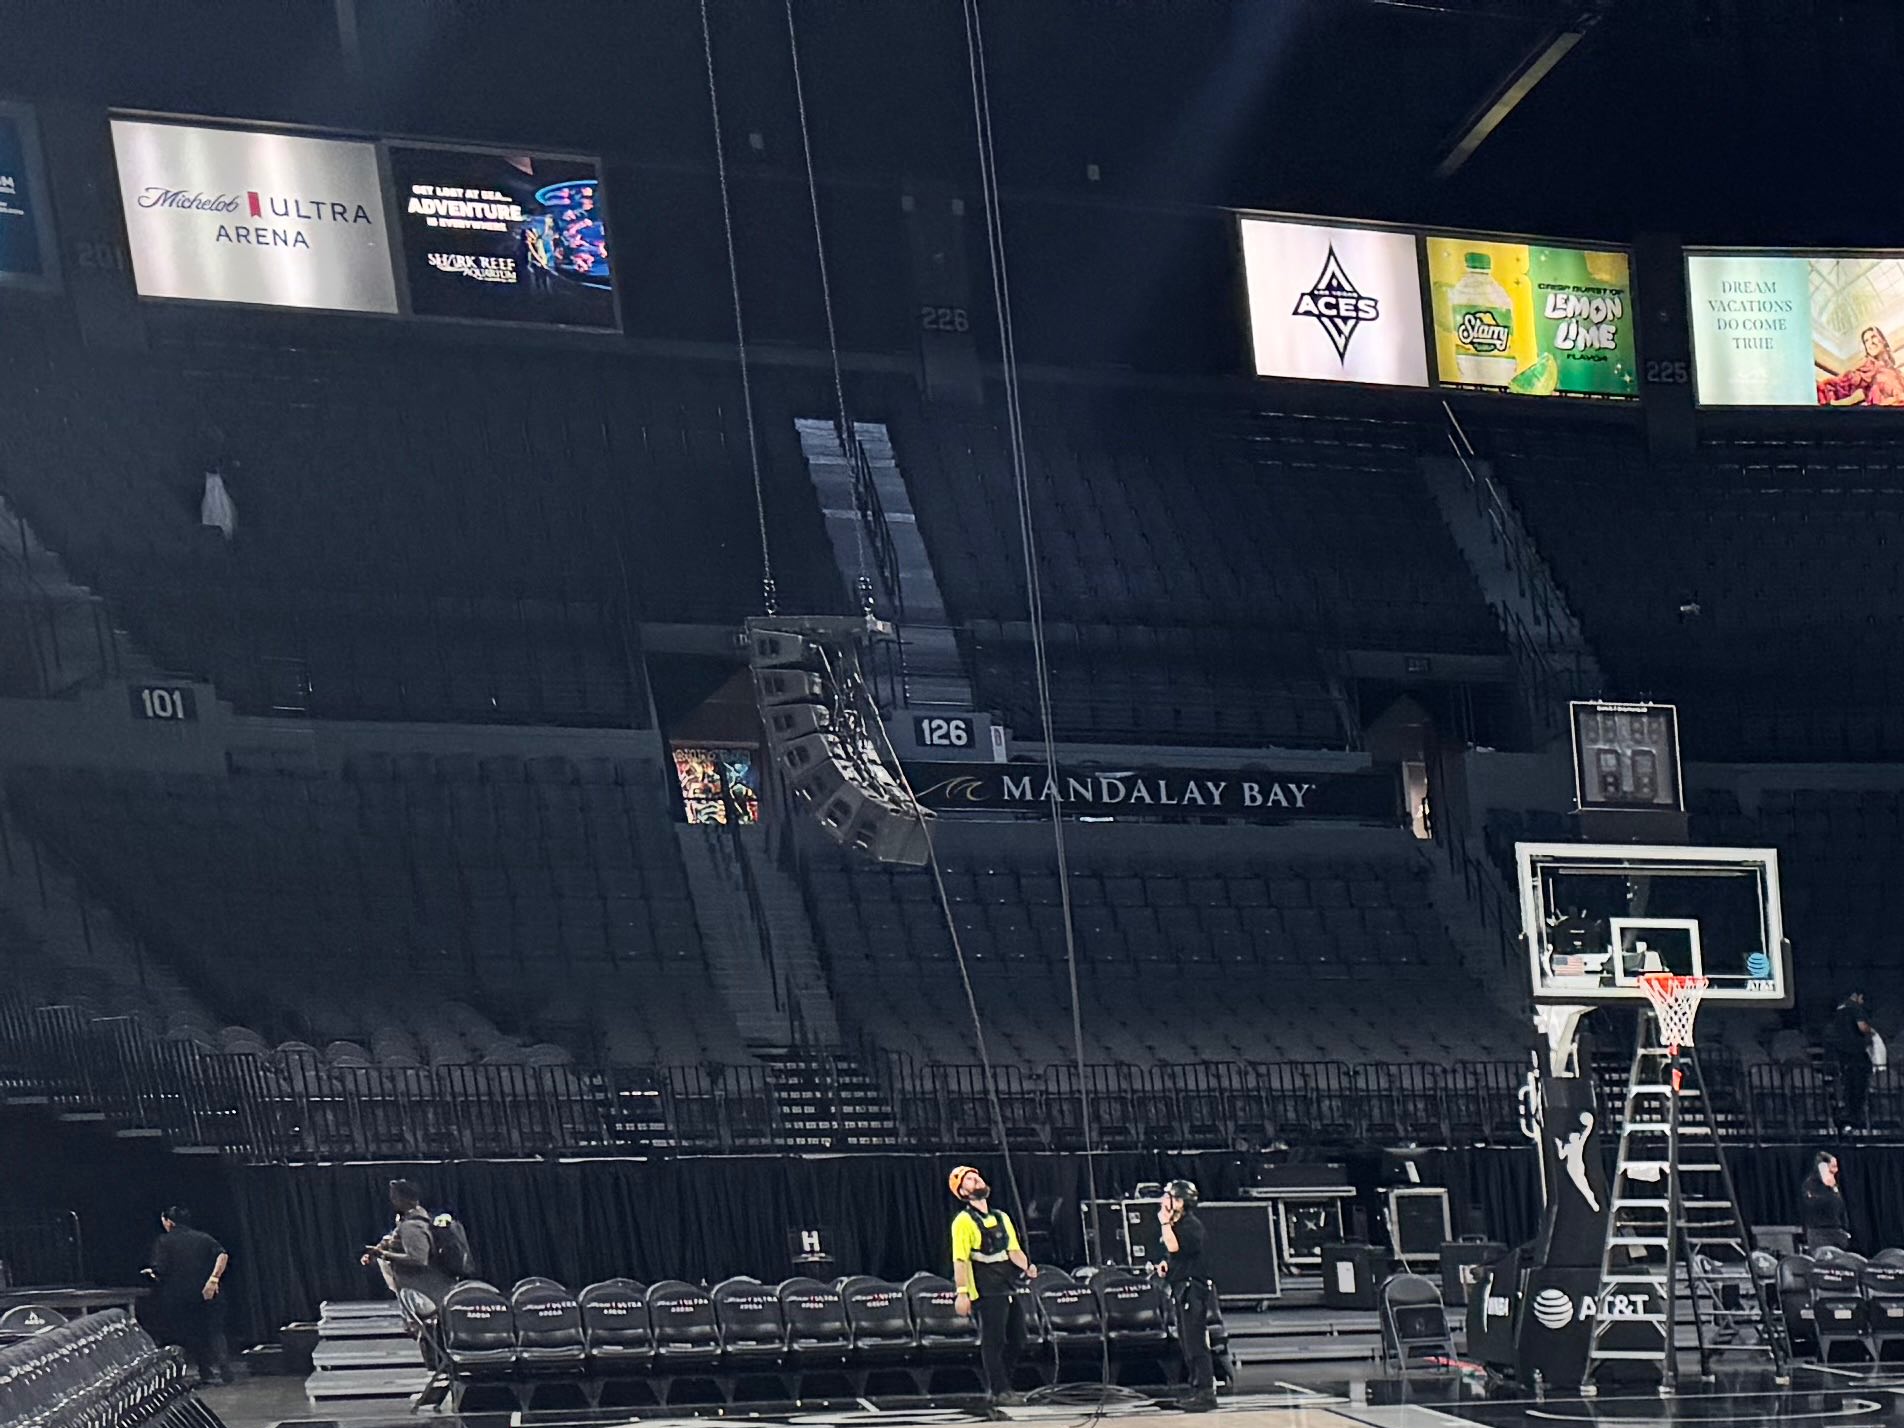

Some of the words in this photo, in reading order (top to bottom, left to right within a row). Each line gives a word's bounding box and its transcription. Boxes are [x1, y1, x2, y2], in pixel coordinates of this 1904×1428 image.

[138, 187, 240, 213] Michelob
[270, 197, 372, 225] ULTRA
[408, 197, 522, 221] ADVENTURE
[216, 224, 310, 248] ARENA
[428, 253, 476, 268] SHARK
[478, 256, 515, 271] REEF
[1722, 281, 1776, 293] DREAM
[1297, 294, 1378, 320] ACES
[1544, 293, 1624, 324] LEMON
[1708, 300, 1793, 312] VACATIONS
[1459, 312, 1509, 351] Starry
[1554, 319, 1618, 351] LIME
[1717, 319, 1739, 330] DO
[1742, 319, 1787, 331] COME
[1732, 337, 1774, 349] TRUE
[1566, 353, 1608, 362] FLAVOR
[1647, 361, 1688, 383] 225
[141, 688, 185, 719] 101
[922, 717, 970, 746] 126
[1002, 775, 1227, 806] MANDALAY
[1242, 782, 1311, 808] BAY
[802, 1230, 820, 1252] H
[1579, 1293, 1650, 1320] AT&T
